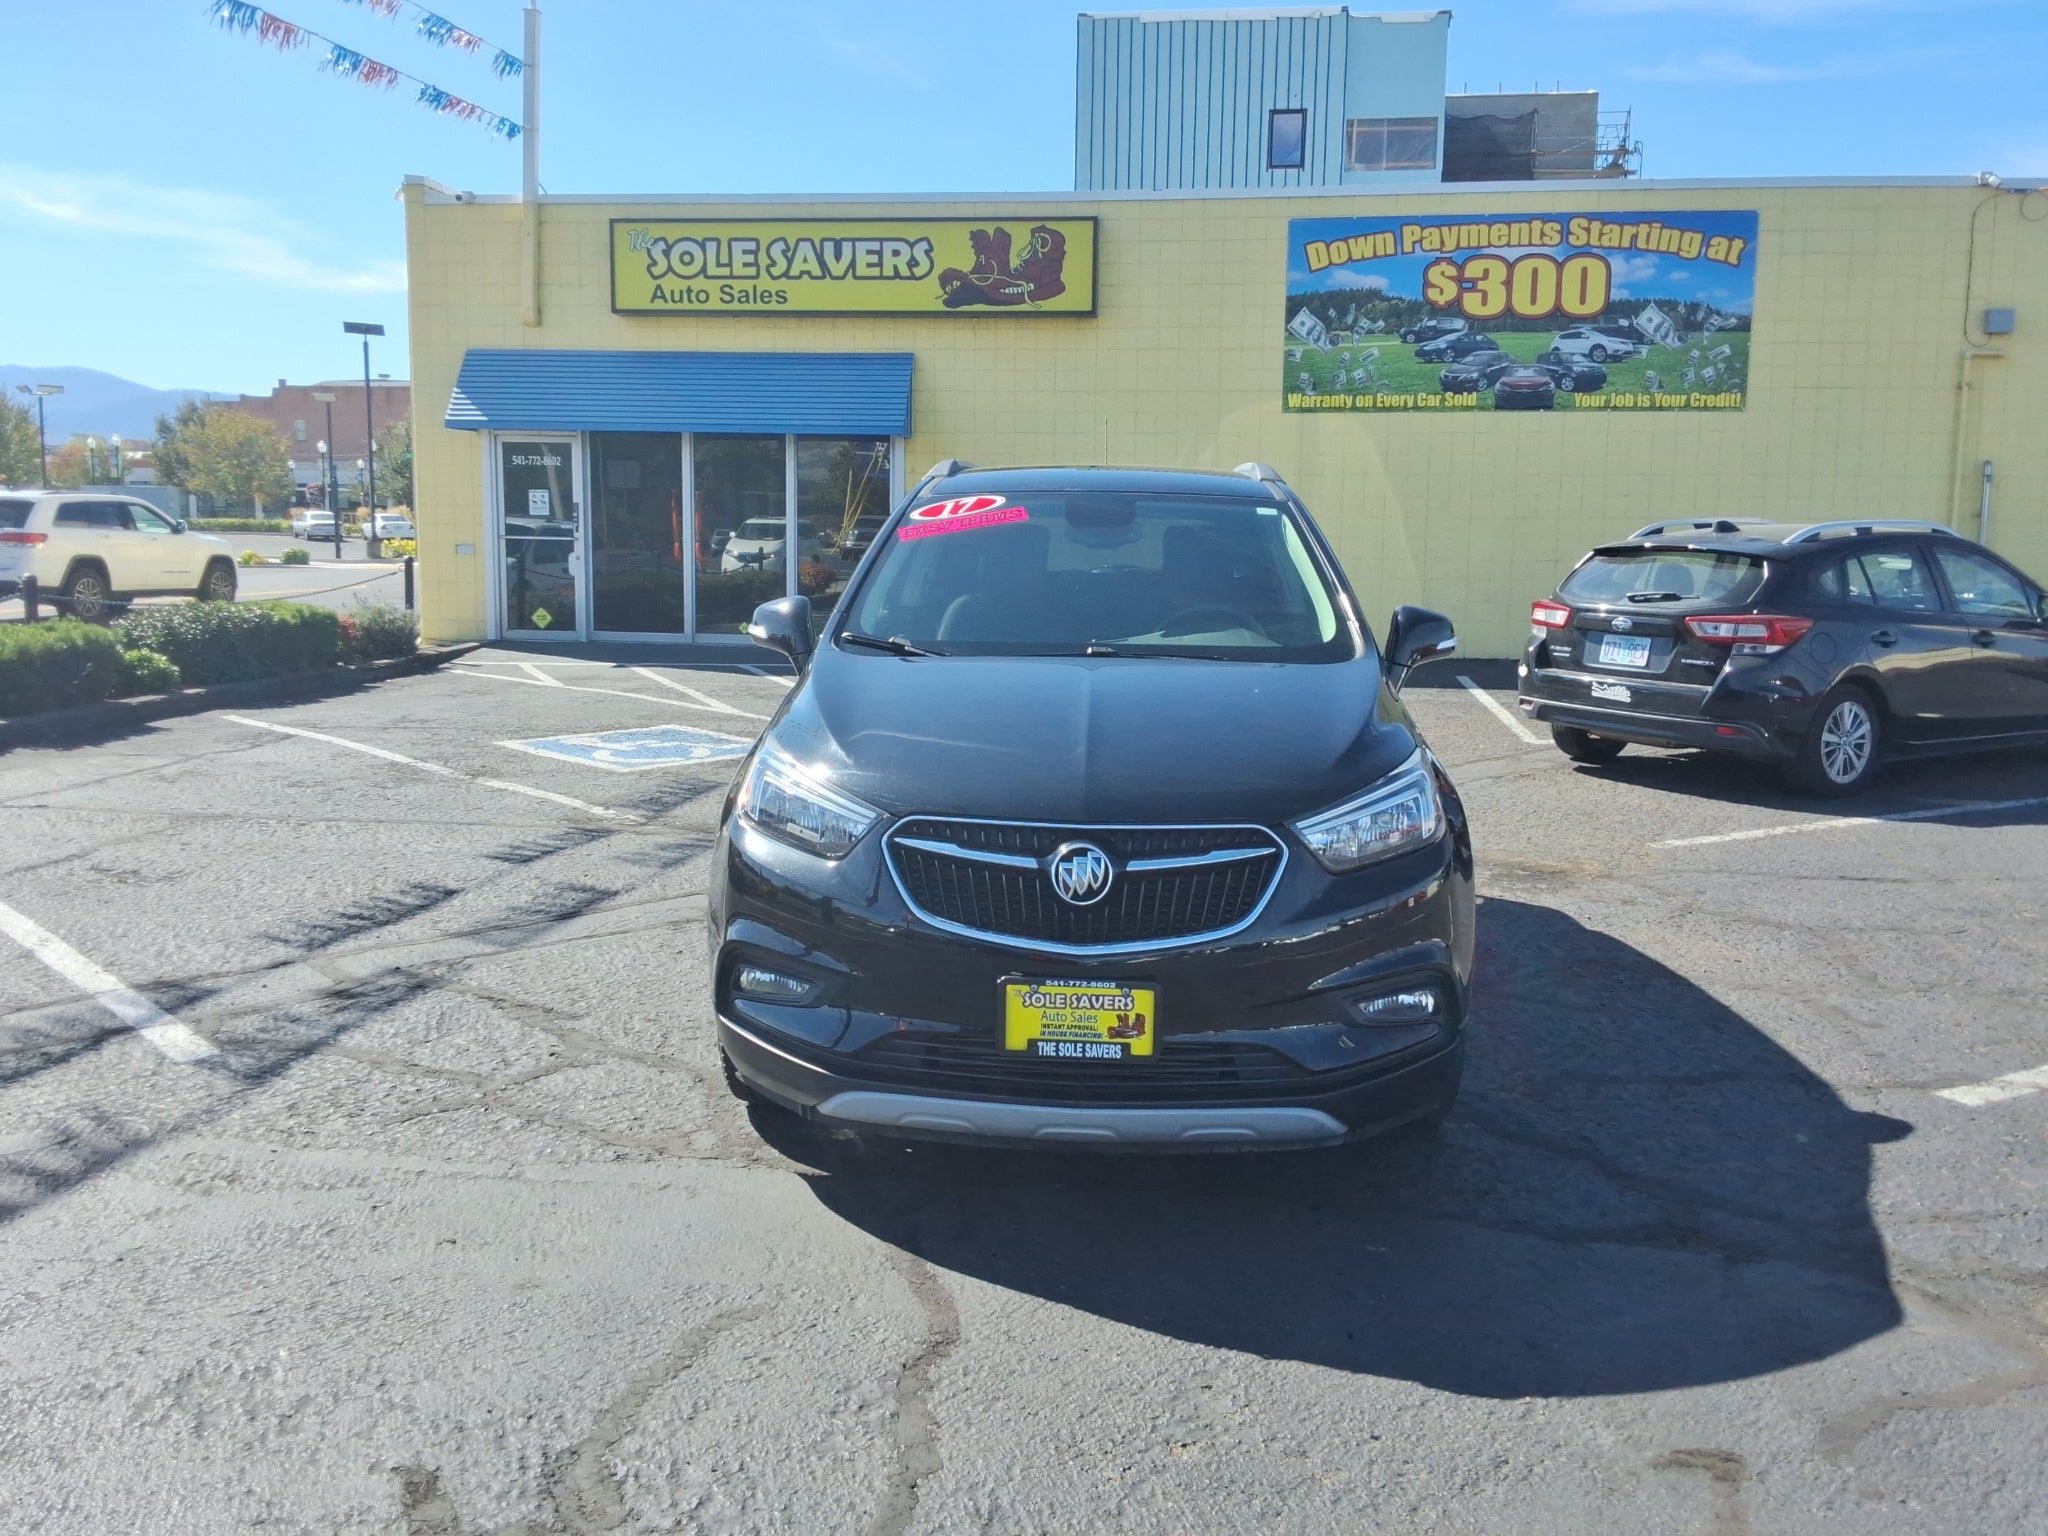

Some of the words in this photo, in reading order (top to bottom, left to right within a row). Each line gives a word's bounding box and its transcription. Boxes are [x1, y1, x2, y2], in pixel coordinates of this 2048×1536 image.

[1304, 229, 1398, 273] Down
[1400, 217, 1560, 255] Payments
[1568, 216, 1705, 259] Starting
[1704, 235, 1748, 268] at
[626, 228, 656, 252] The
[646, 237, 762, 280] SOLE
[766, 237, 935, 281] SAVERS
[650, 285, 710, 305] Auto
[719, 284, 789, 305] Sales
[1422, 252, 1612, 319] $300
[1288, 392, 1353, 409] Warranty
[1355, 395, 1374, 408] on
[1376, 392, 1415, 410] Every
[1417, 392, 1444, 408] Car
[1446, 391, 1477, 408] Sold
[1574, 391, 1607, 408] Your
[1609, 391, 1636, 408] Job
[1637, 391, 1650, 408] is
[1652, 391, 1686, 408] Your
[1688, 391, 1741, 408] Credit!
[512, 455, 562, 466] 541-772-8602
[937, 499, 981, 517] 17
[904, 521, 954, 538] EASY
[958, 509, 1023, 528] TERMS
[1022, 992, 1067, 1009] SOLE
[1070, 993, 1135, 1012] SAVERS
[1041, 1010, 1067, 1022] Auto
[1070, 1011, 1098, 1024] Sales
[1037, 1041, 1060, 1056] THE
[1061, 1043, 1083, 1057] SOLE
[1085, 1043, 1122, 1059] SAVERS
